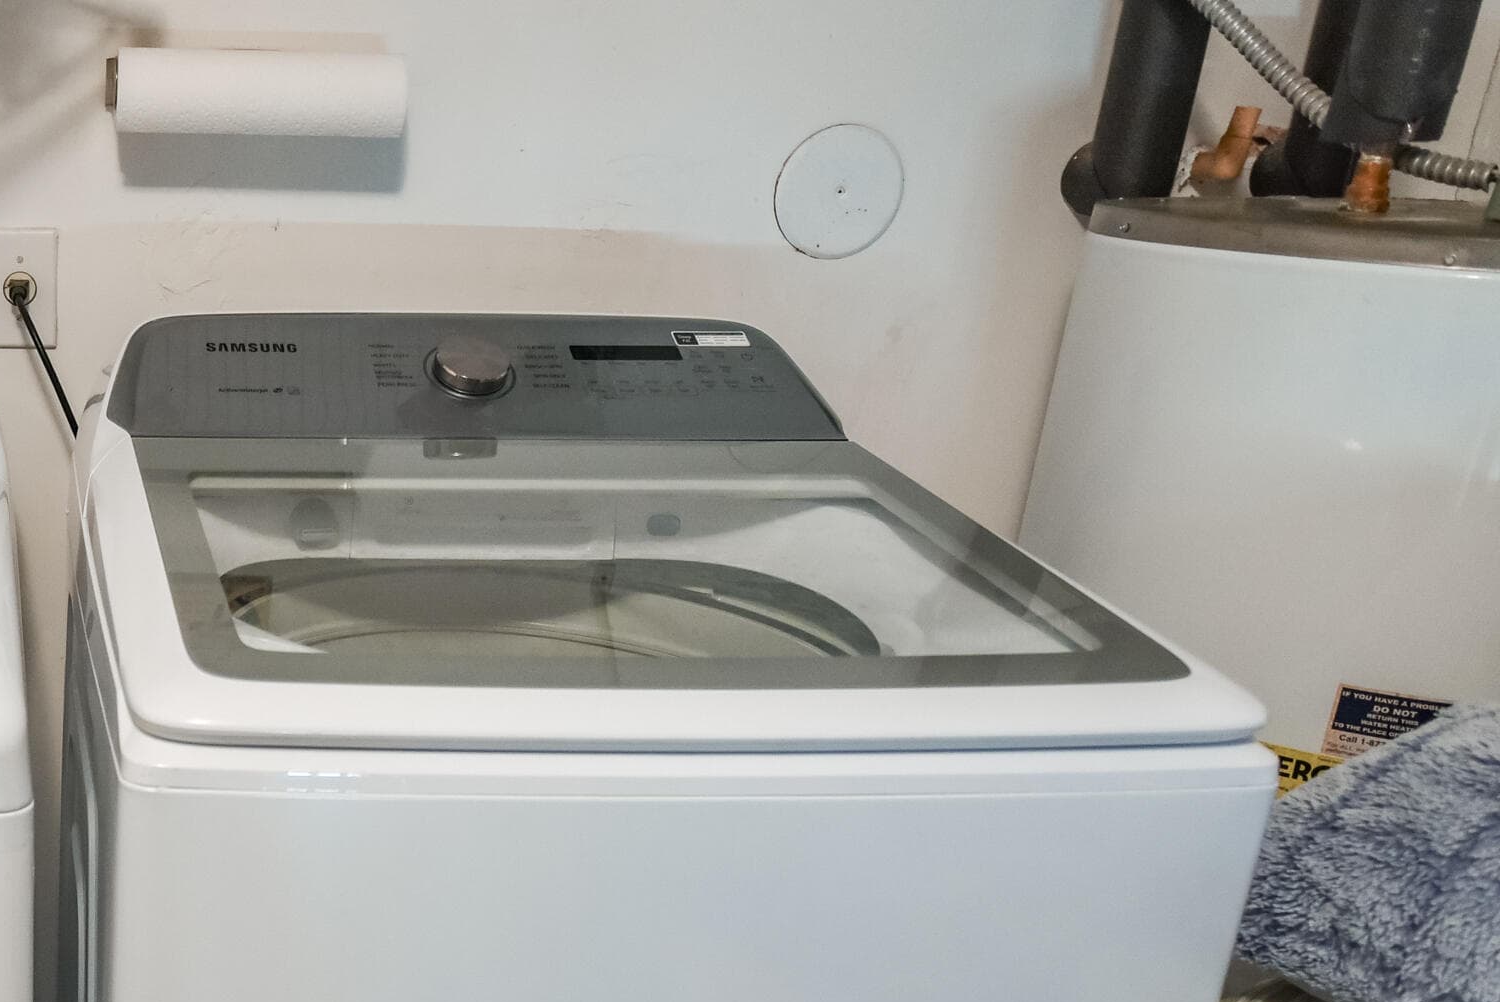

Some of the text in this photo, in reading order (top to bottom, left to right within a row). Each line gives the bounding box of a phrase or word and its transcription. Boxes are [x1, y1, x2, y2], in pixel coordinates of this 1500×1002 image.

[205, 342, 298, 353] SAMSUNG
[1353, 693, 1373, 701] YOU
[1374, 697, 1400, 706] HAVE
[1372, 705, 1418, 718] DO NOT
[1360, 719, 1388, 730] WATER
[1366, 713, 1419, 726] RETURN THIS
[1334, 721, 1345, 729] TO
[1346, 724, 1361, 732] THE
[1362, 727, 1388, 736] PLACE
[1338, 734, 1358, 744] Call
